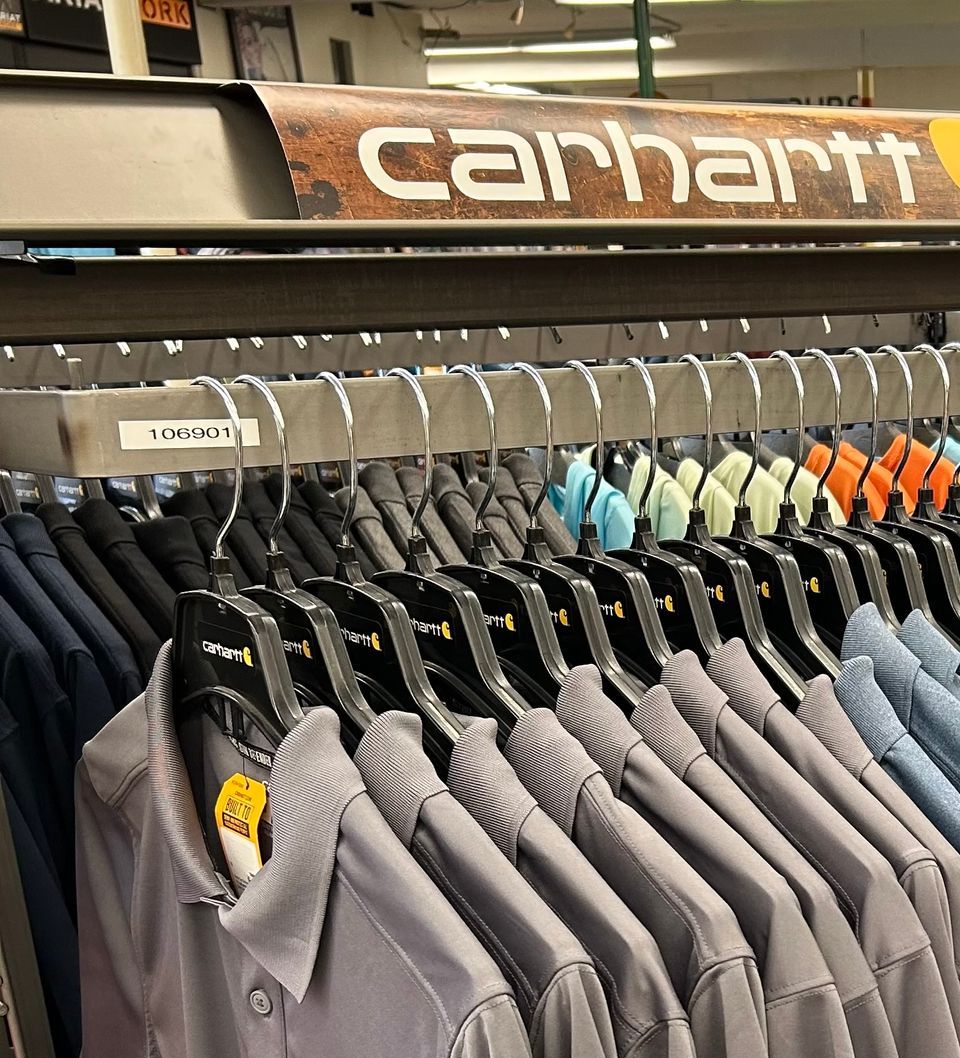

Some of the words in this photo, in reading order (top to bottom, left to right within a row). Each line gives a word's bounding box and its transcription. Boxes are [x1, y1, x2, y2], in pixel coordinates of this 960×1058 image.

[0, 11, 21, 22] RIAT
[142, 0, 189, 25] ORK
[358, 121, 919, 203] carhartt
[148, 427, 230, 440] 106901
[409, 618, 441, 637] hartt
[483, 614, 504, 629] artt
[341, 627, 371, 647] hartt
[202, 640, 244, 663] carhartt
[283, 640, 303, 656] artt
